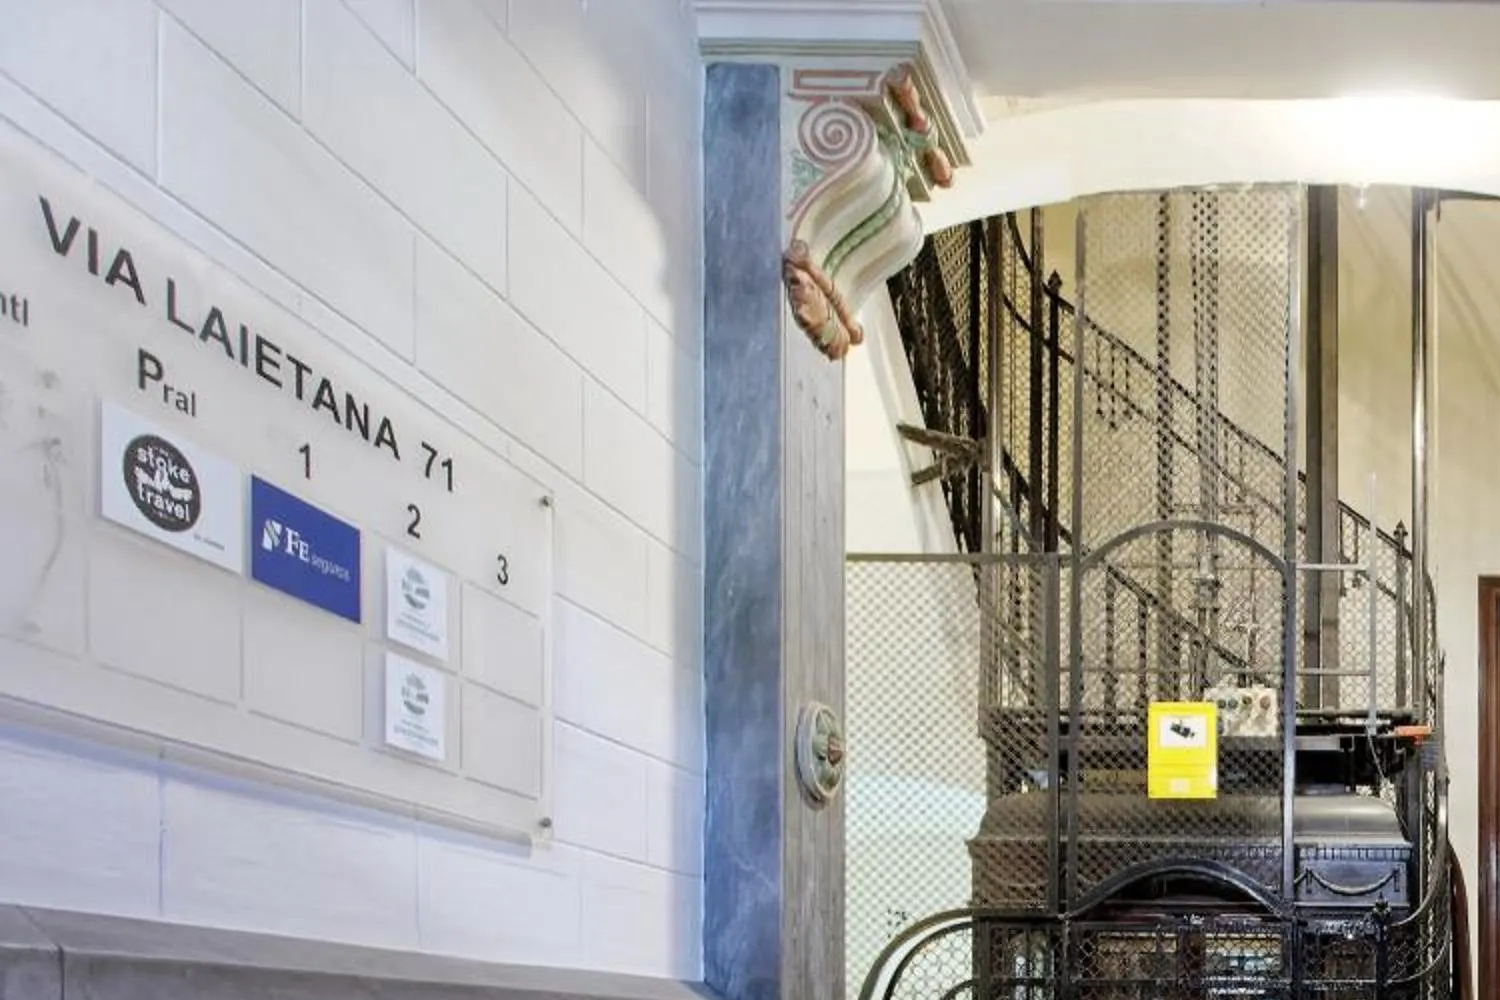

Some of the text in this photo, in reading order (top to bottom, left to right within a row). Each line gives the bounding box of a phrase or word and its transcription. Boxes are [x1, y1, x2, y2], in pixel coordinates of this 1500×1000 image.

[39, 196, 454, 492] VIA LAIETANA 71
[137, 347, 196, 418] Pral
[136, 445, 191, 484] stoke
[298, 444, 312, 479] 1
[137, 480, 190, 523] travel
[407, 504, 421, 538] 2
[284, 526, 310, 564] FE
[496, 554, 509, 586] 3
